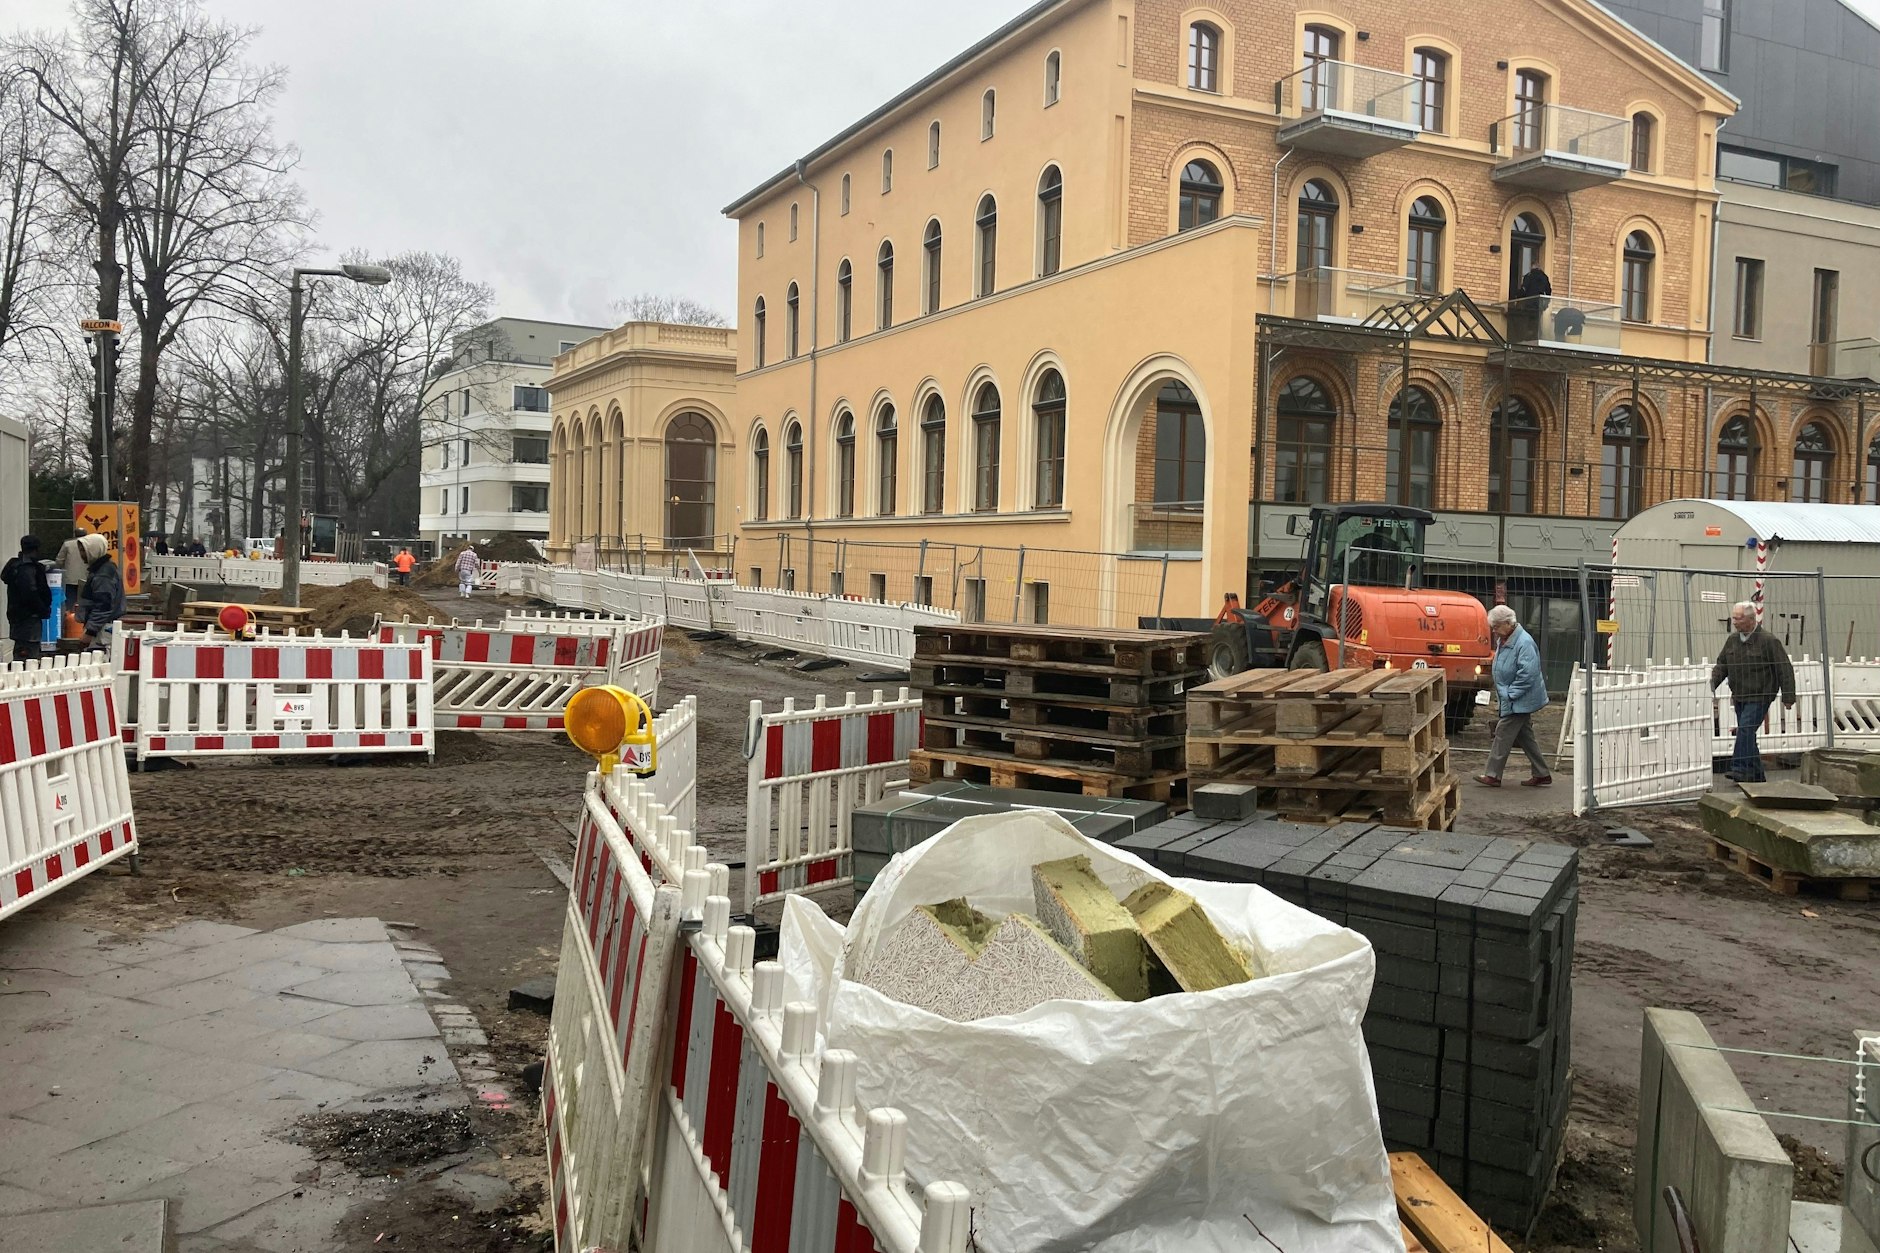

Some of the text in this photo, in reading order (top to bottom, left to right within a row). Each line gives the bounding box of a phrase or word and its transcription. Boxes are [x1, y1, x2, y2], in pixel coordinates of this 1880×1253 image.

[81, 321, 110, 330] FALCON
[1418, 618, 1445, 631] 1433
[640, 752, 651, 762] BVS
